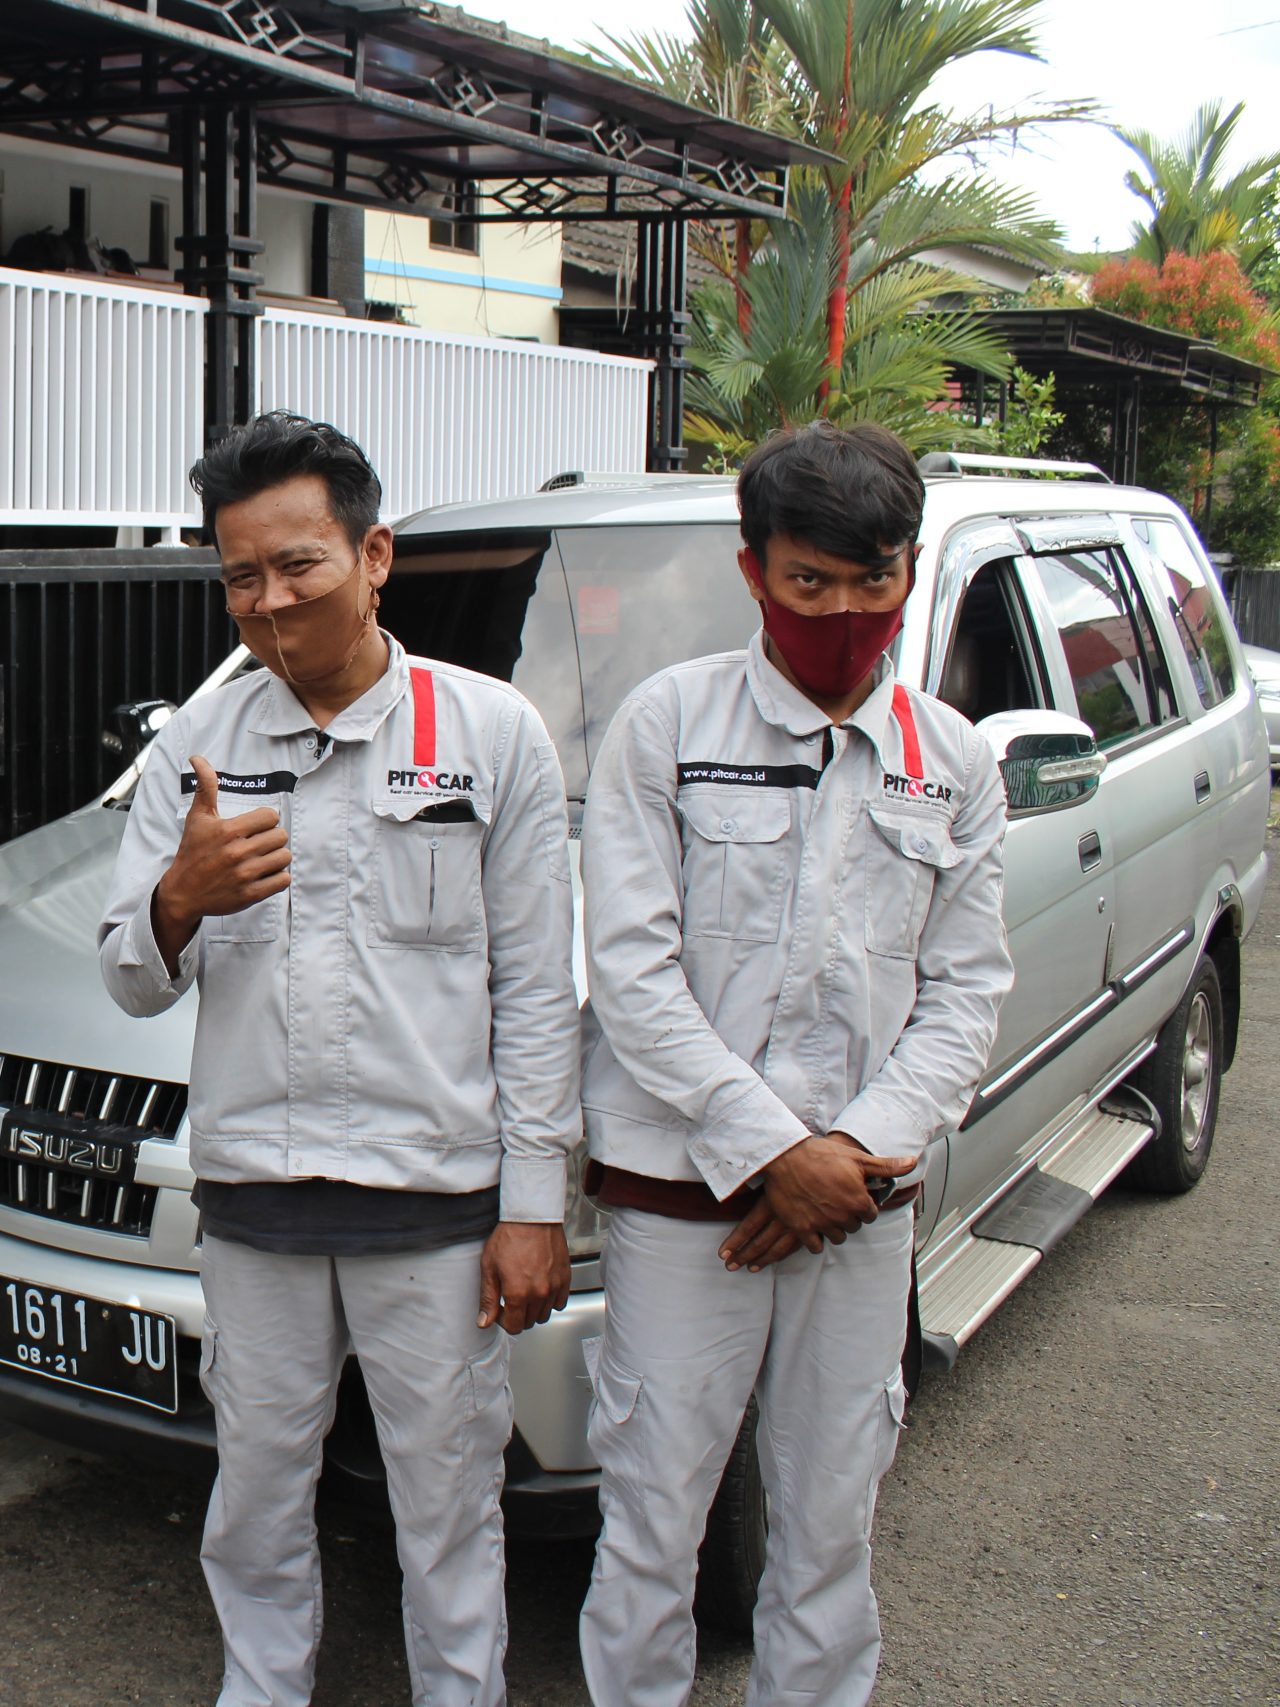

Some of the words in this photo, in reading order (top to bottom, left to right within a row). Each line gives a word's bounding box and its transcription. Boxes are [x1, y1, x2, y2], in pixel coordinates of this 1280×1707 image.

[683, 769, 766, 781] www.pitcar.co.id
[9, 1127, 122, 1174] ISUZU
[6, 1283, 87, 1352] 1611
[121, 1312, 166, 1371] JU
